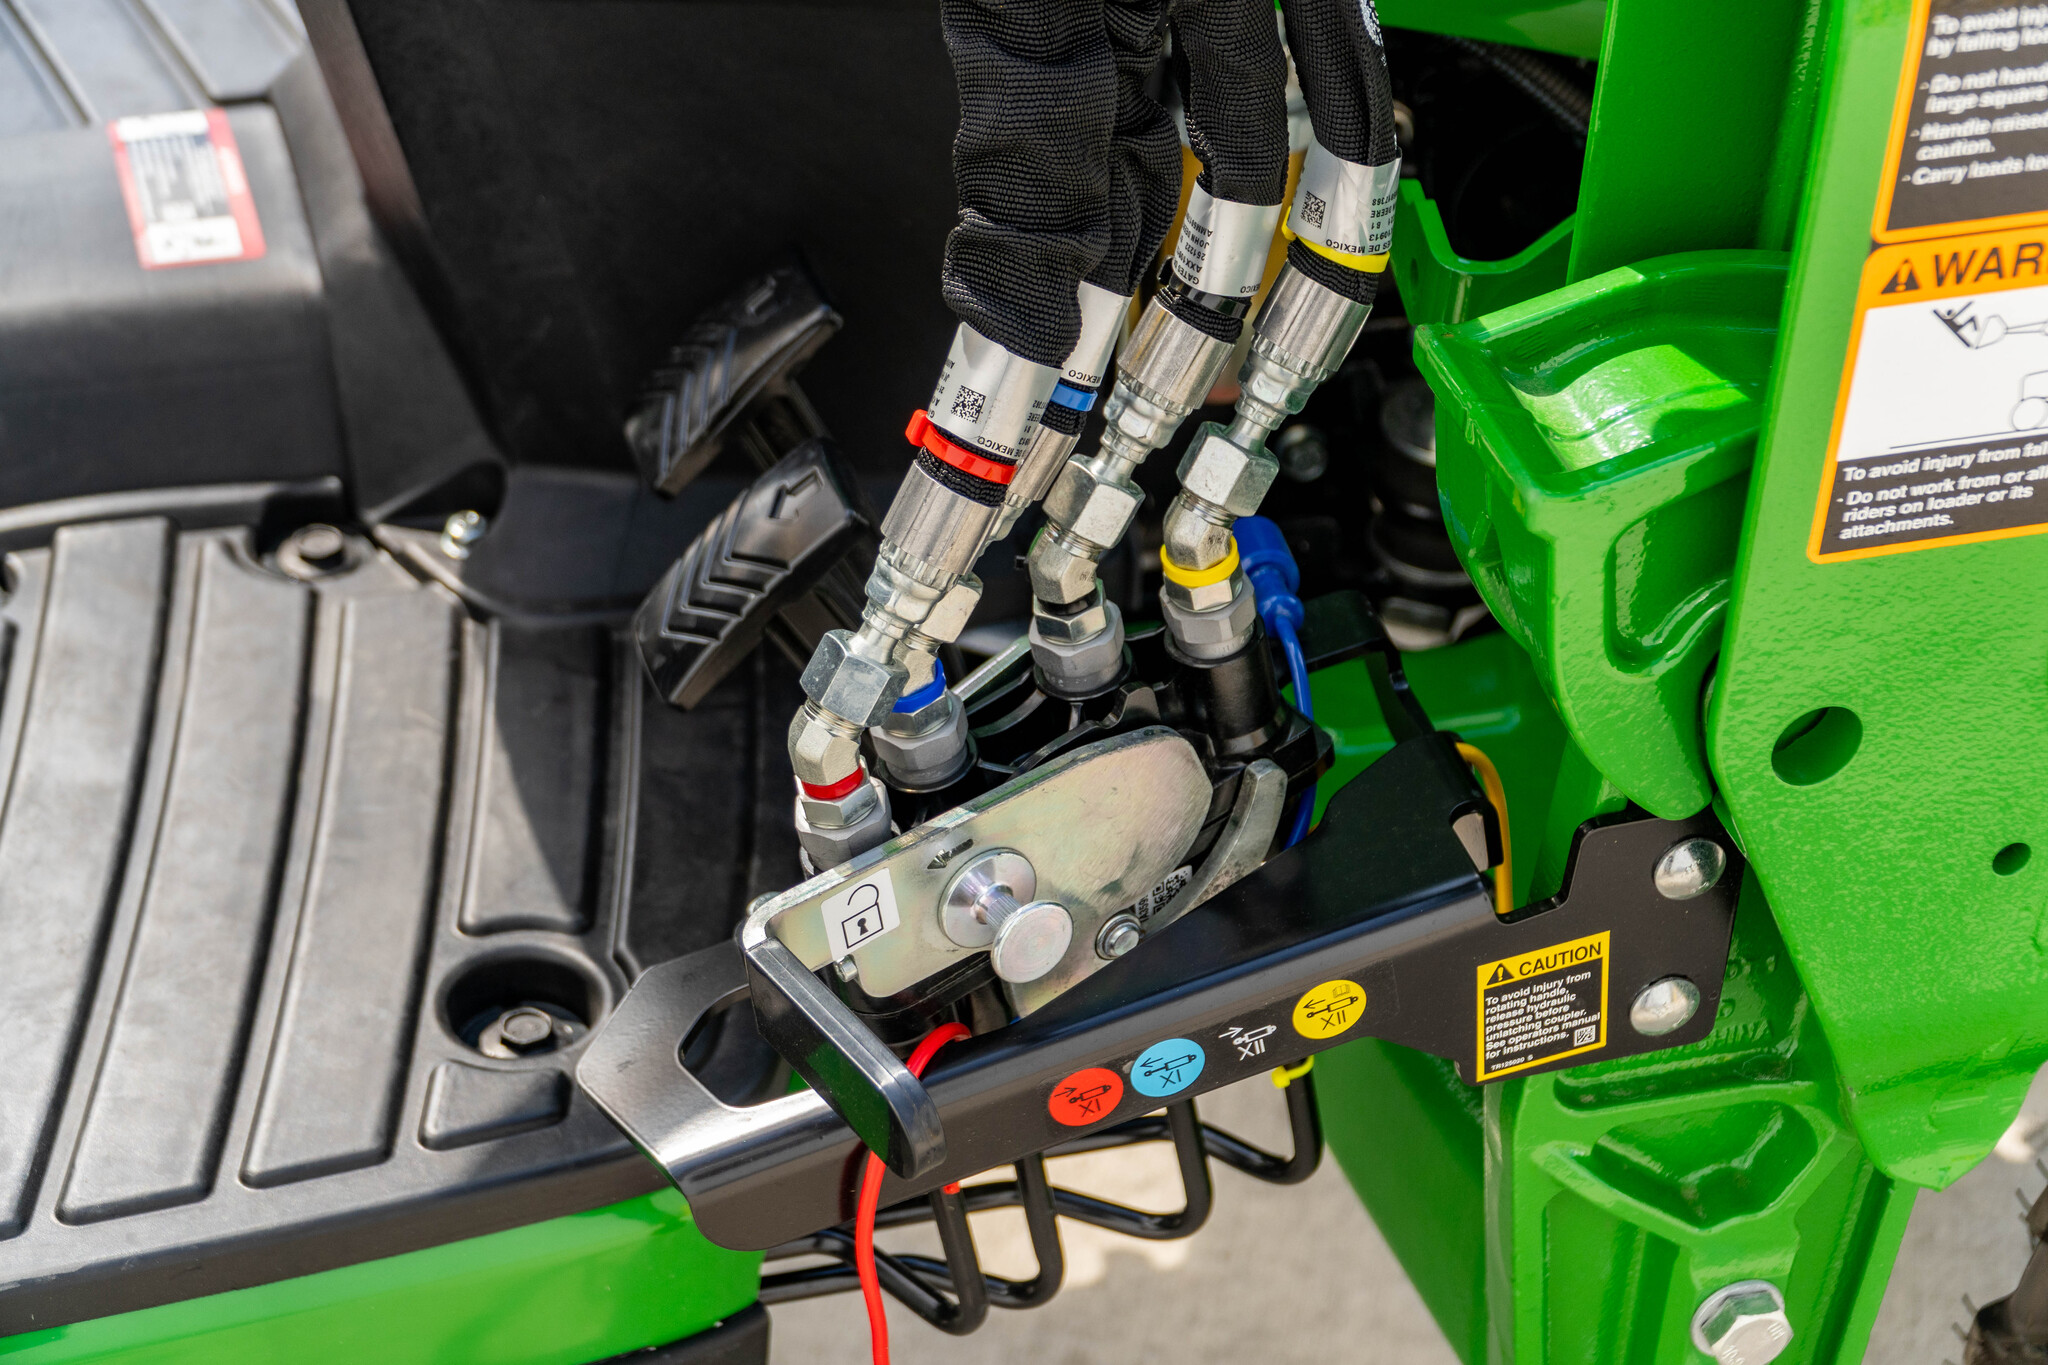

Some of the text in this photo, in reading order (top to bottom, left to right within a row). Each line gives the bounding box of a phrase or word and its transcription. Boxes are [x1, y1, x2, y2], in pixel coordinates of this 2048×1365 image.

[1932, 14, 1960, 36] To
[1960, 7, 2019, 33] avoid
[1929, 74, 1962, 94] Do
[1961, 68, 1998, 90] not
[1919, 117, 1992, 142] Handle
[1911, 165, 1968, 186] Carry
[1967, 156, 2024, 179] loads
[1191, 235, 1210, 249] JOHN
[1326, 239, 1365, 254] MEXICO
[1368, 244, 1380, 253] DE
[1178, 264, 1199, 285] GATES
[977, 436, 1014, 457] MEXICO
[1842, 466, 1866, 481] To
[1868, 458, 1921, 478] avoid
[1921, 453, 1976, 472] injury
[1977, 448, 2021, 463] from
[1845, 491, 1873, 505] Do
[1875, 485, 1908, 501] not
[1909, 478, 1956, 496] work
[1956, 475, 2001, 490] from
[2002, 471, 2025, 484] or
[1842, 485, 2034, 523] riders on loader or its
[1839, 513, 1954, 539] attachments.
[1519, 941, 1601, 976] CAUTION
[1485, 971, 1592, 1006] To avoid injury from
[1485, 998, 1527, 1016] rotating
[1485, 993, 1577, 1024] release hydraulic
[1485, 1004, 1570, 1035] pressure before
[1320, 1009, 1347, 1031] XII
[1485, 1021, 1542, 1042] unlatching
[1485, 1012, 1601, 1051] See operators manual
[1237, 1039, 1265, 1061] XII
[1485, 1049, 1501, 1060] for
[1160, 1069, 1182, 1089] XI
[1079, 1100, 1101, 1117] XI
